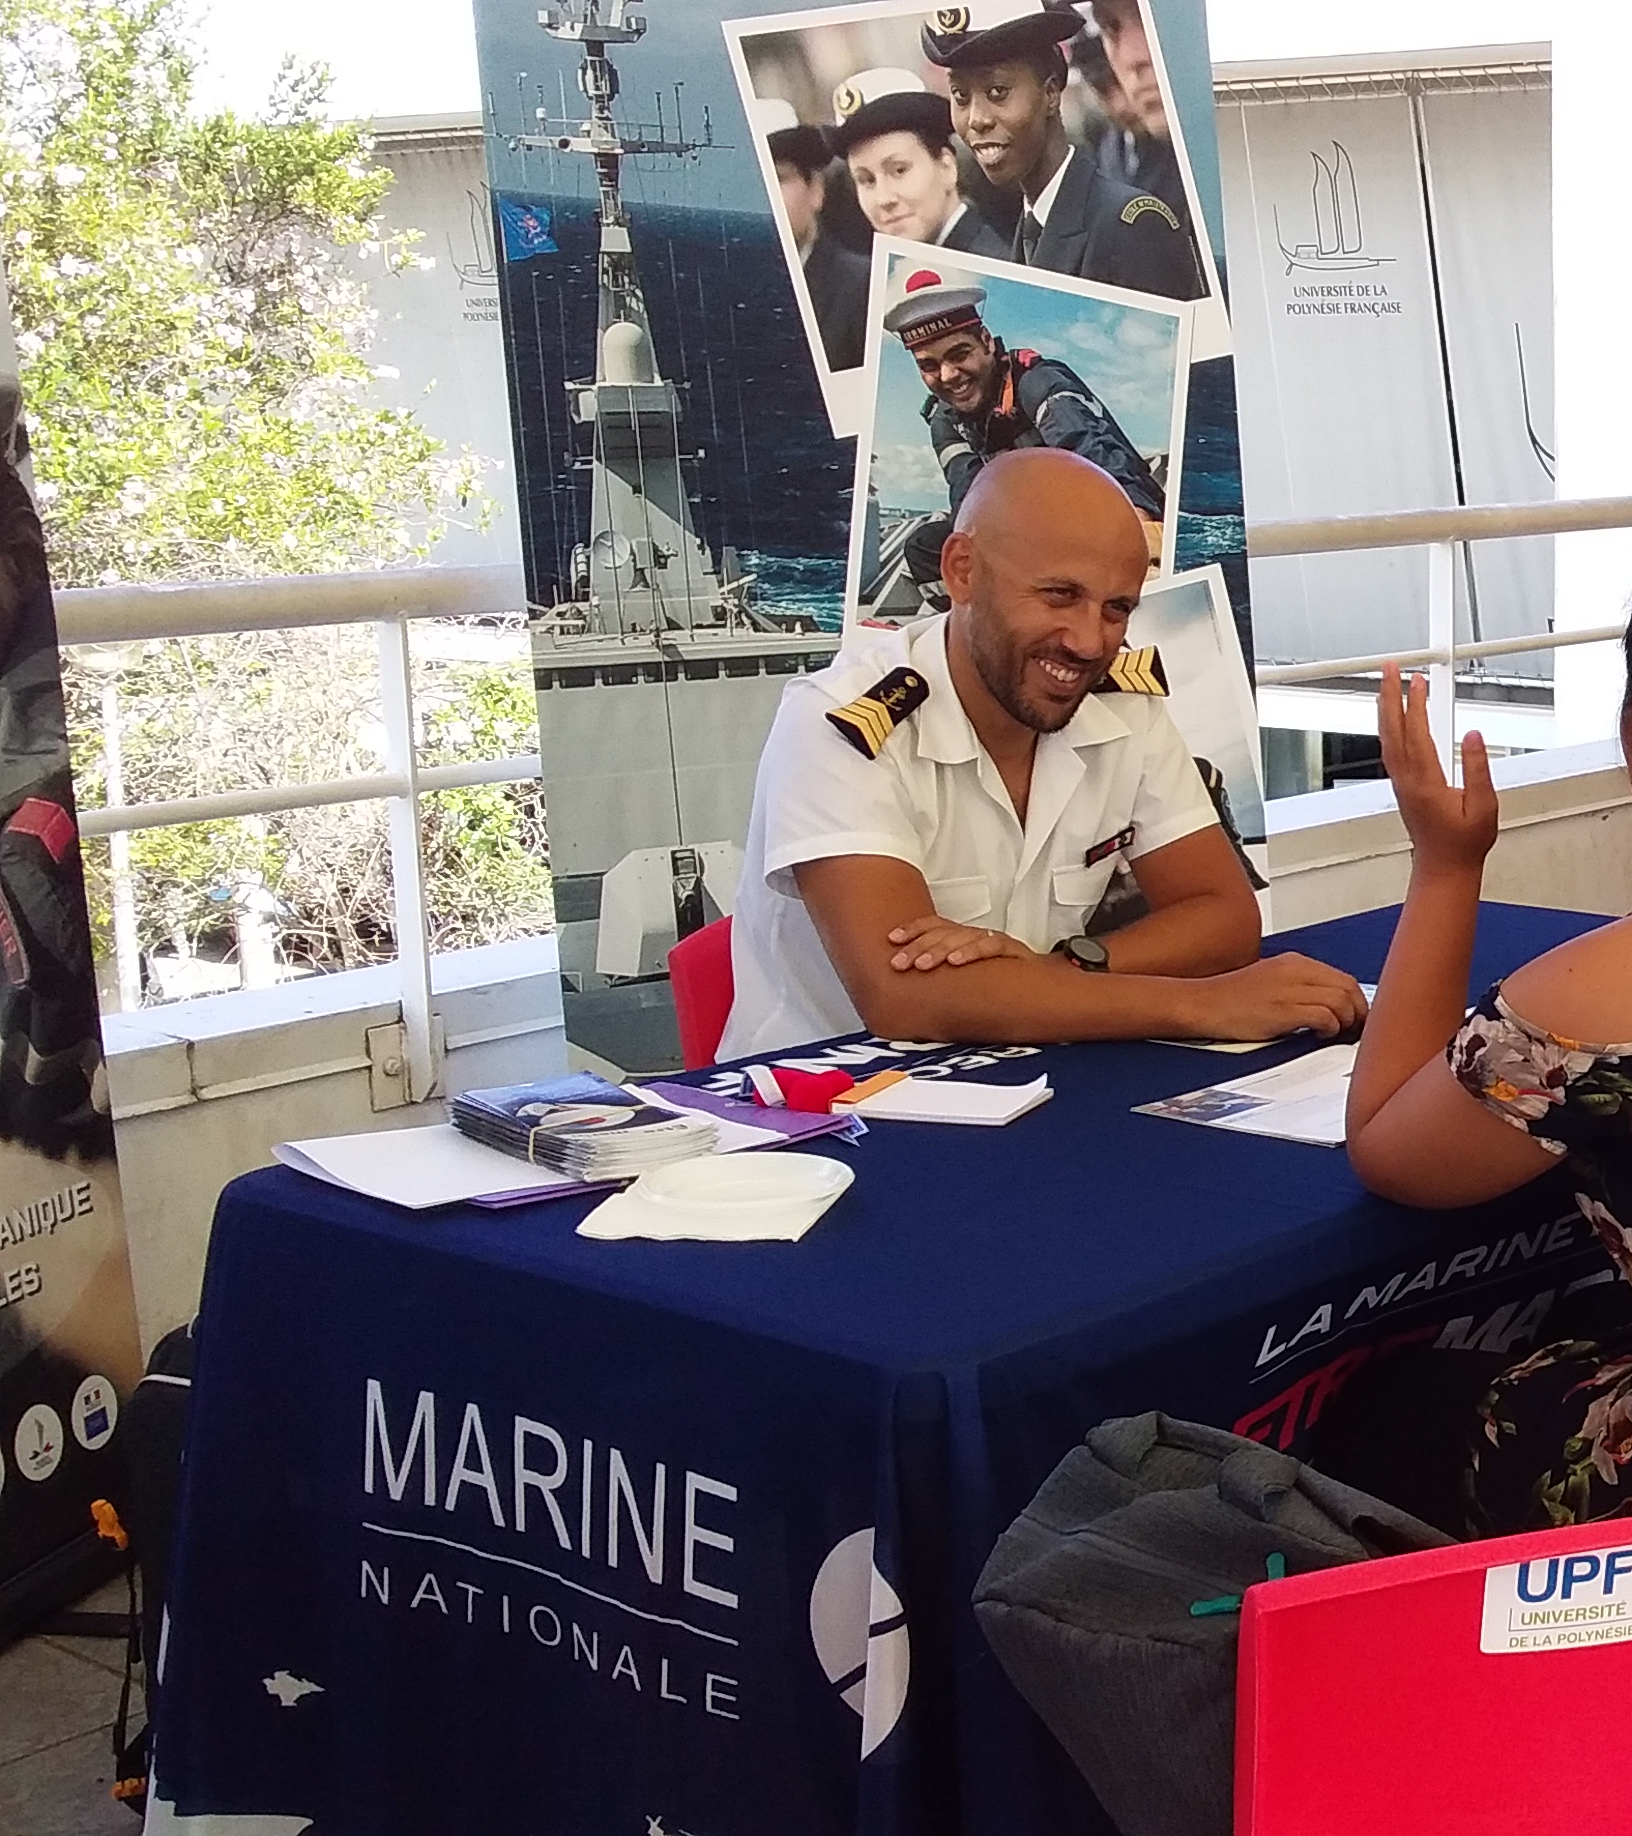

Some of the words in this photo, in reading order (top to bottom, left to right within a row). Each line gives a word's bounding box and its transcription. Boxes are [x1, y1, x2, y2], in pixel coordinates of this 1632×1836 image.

[1294, 280, 1355, 297] UNIVERSITÉ
[1357, 285, 1371, 297] DE
[1373, 285, 1388, 296] LA
[1286, 299, 1342, 315] POLYNÉSIE
[1344, 302, 1402, 318] FRANÇAISE
[1255, 1303, 1333, 1369] LA
[1344, 1211, 1582, 1320] MARINE
[364, 1377, 739, 1609] MARINE
[1520, 1601, 1628, 1626] UNIVERSITÉ
[360, 1559, 741, 1720] NATIONALE
[1508, 1636, 1529, 1648] DE
[1532, 1634, 1553, 1647] LA
